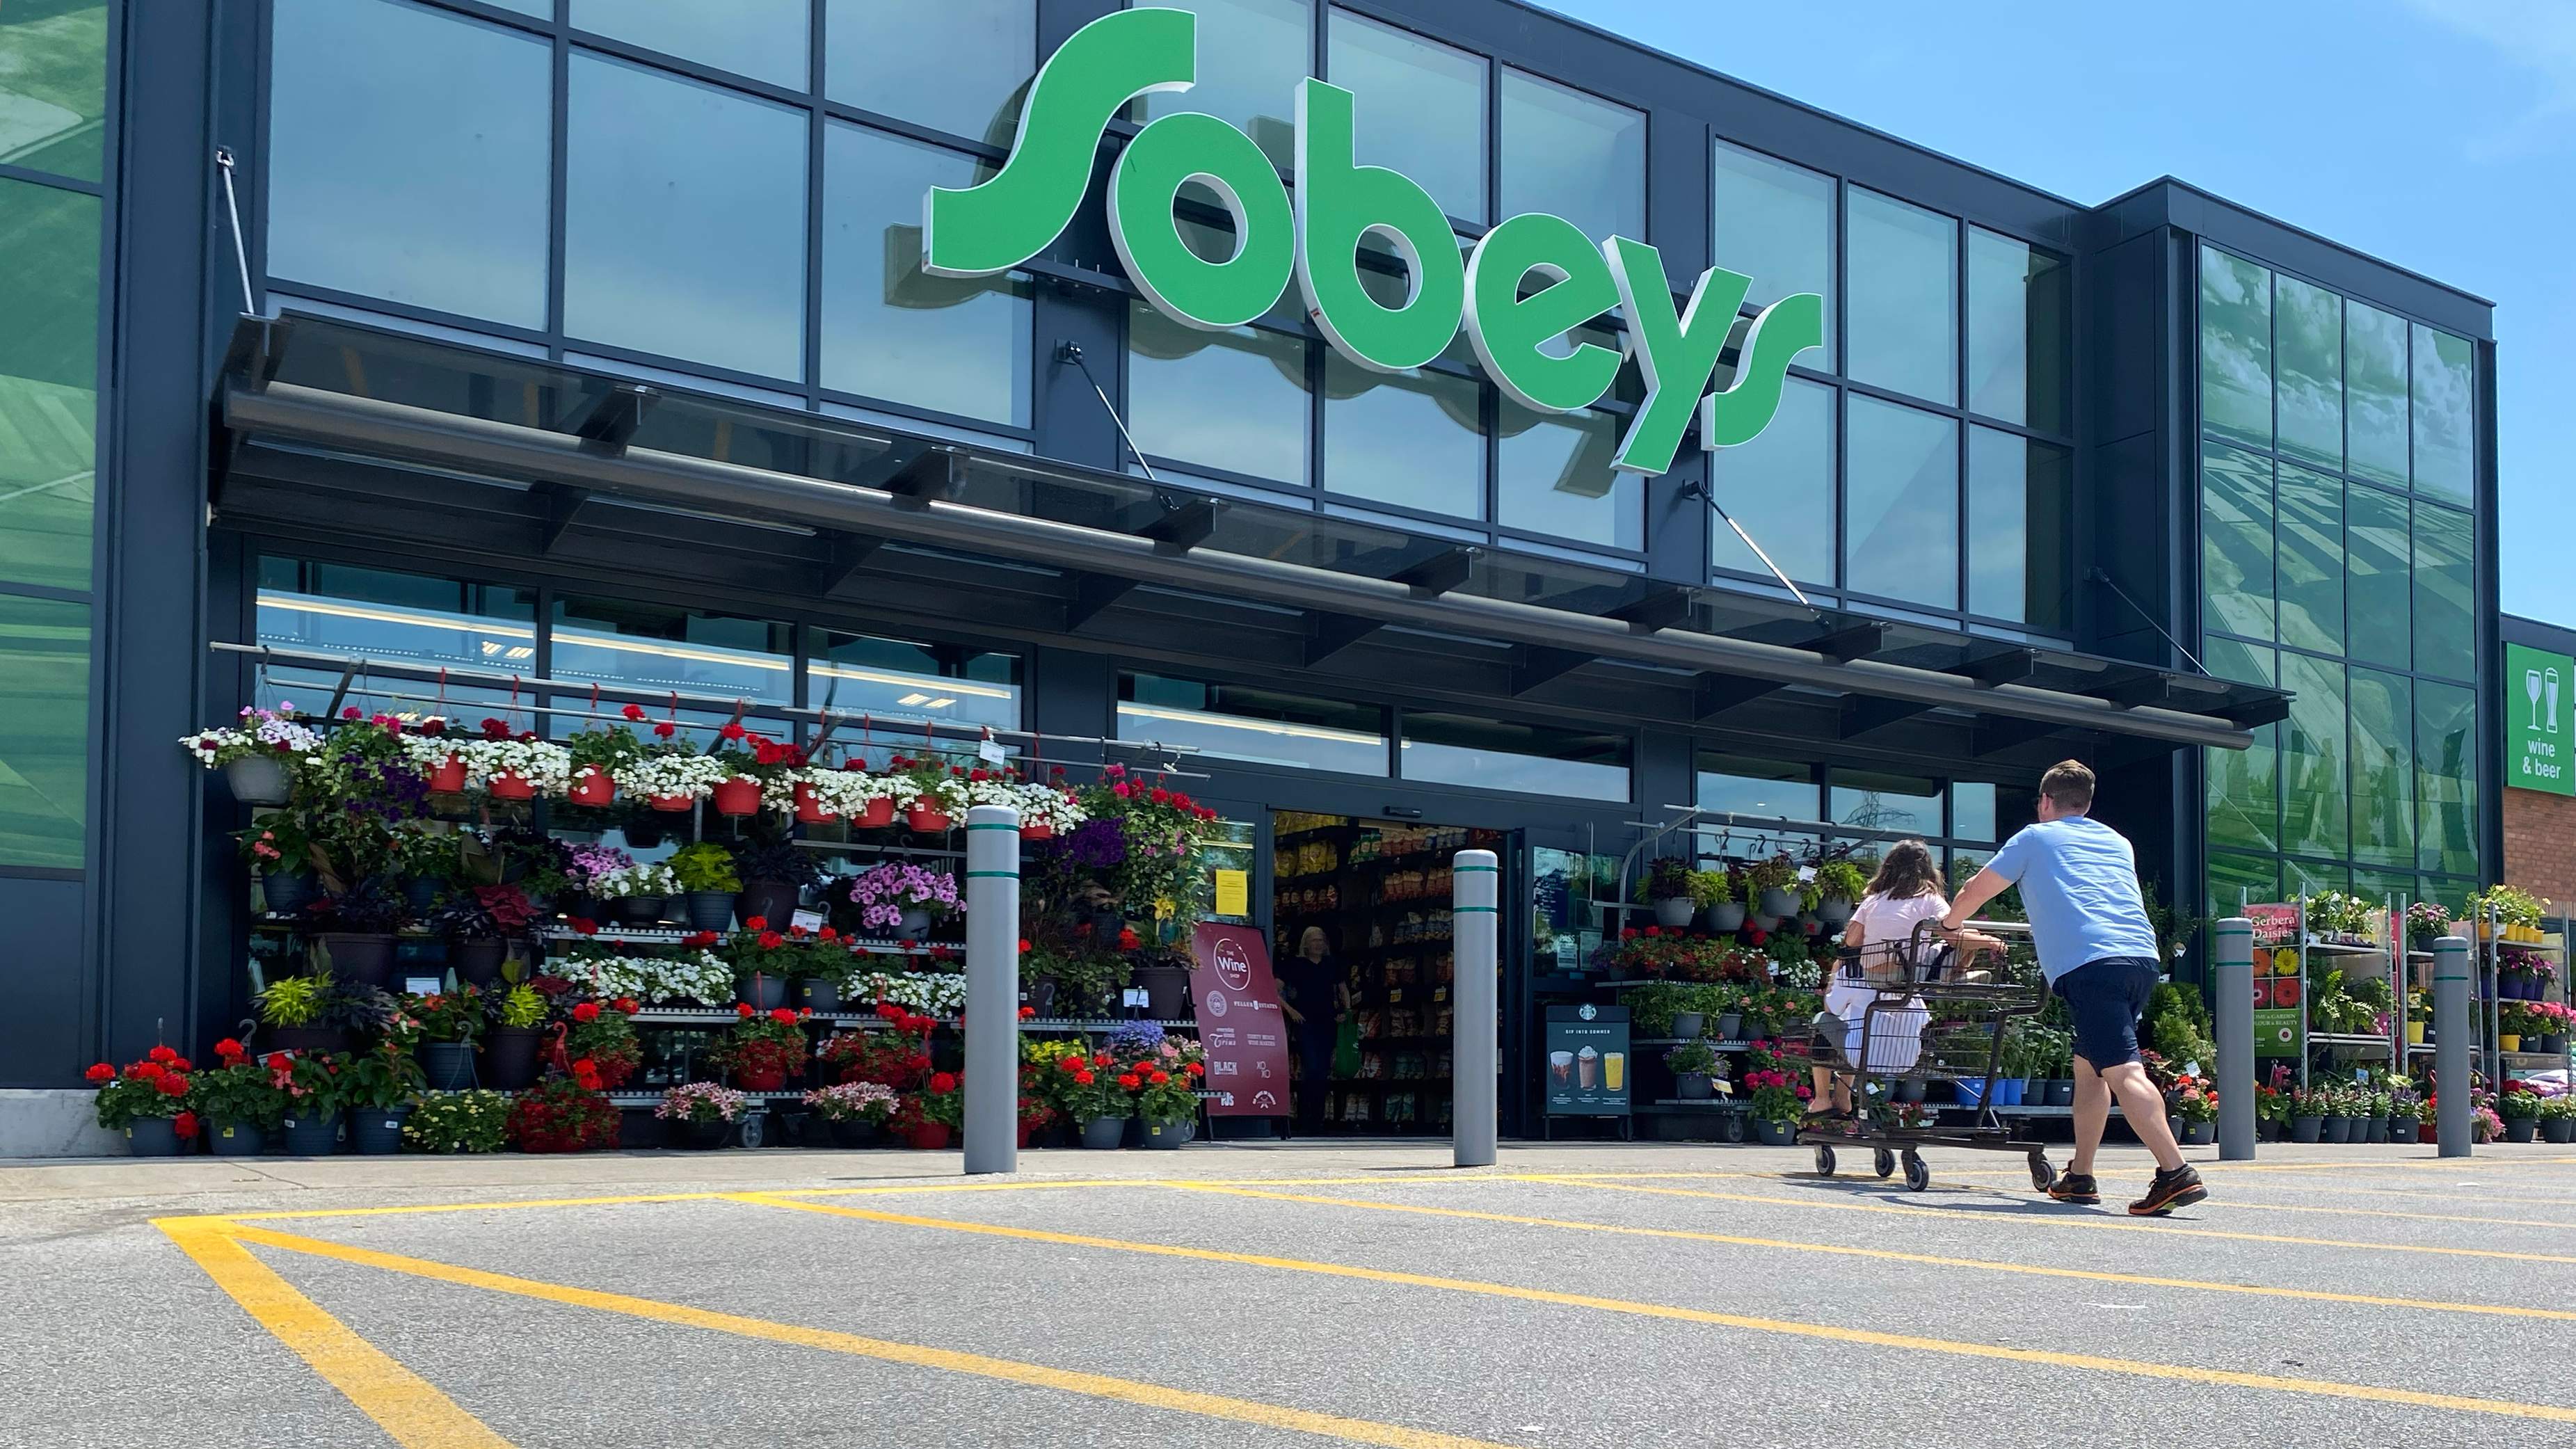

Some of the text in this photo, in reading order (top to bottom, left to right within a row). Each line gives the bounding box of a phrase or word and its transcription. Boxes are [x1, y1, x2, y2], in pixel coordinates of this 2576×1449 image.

[922, 6, 1823, 477] Sobeys
[2527, 737, 2555, 758] wine
[2523, 755, 2561, 779] & beer
[2251, 915, 2295, 927] Gerbera
[2253, 927, 2294, 940] Daisies
[1217, 956, 1247, 972] Wine
[1213, 1061, 1238, 1075] BLACK
